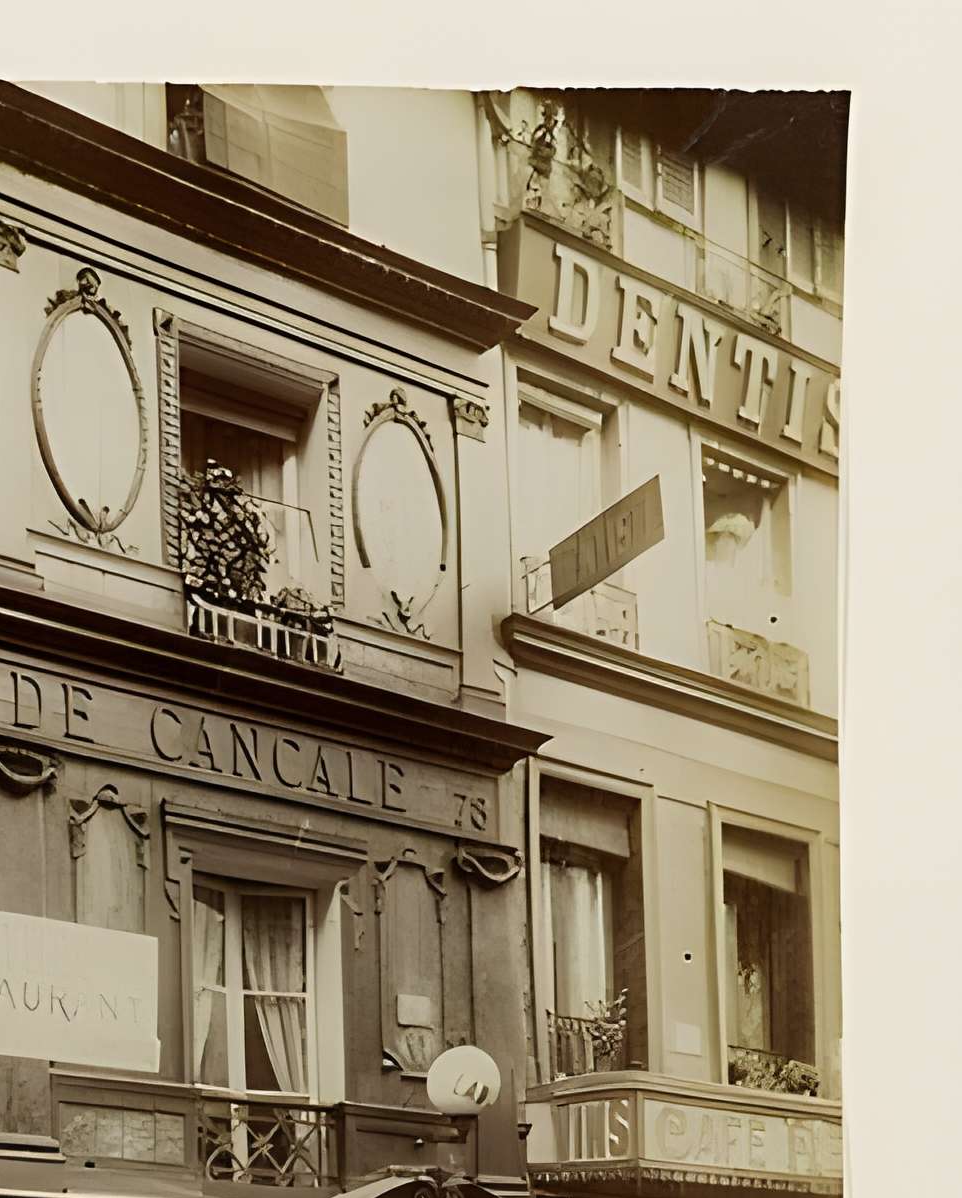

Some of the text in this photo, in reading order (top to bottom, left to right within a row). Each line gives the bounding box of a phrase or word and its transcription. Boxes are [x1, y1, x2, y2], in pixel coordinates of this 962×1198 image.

[8, 670, 95, 744] DE
[148, 705, 408, 813] CANCALE
[452, 791, 488, 832] 78
